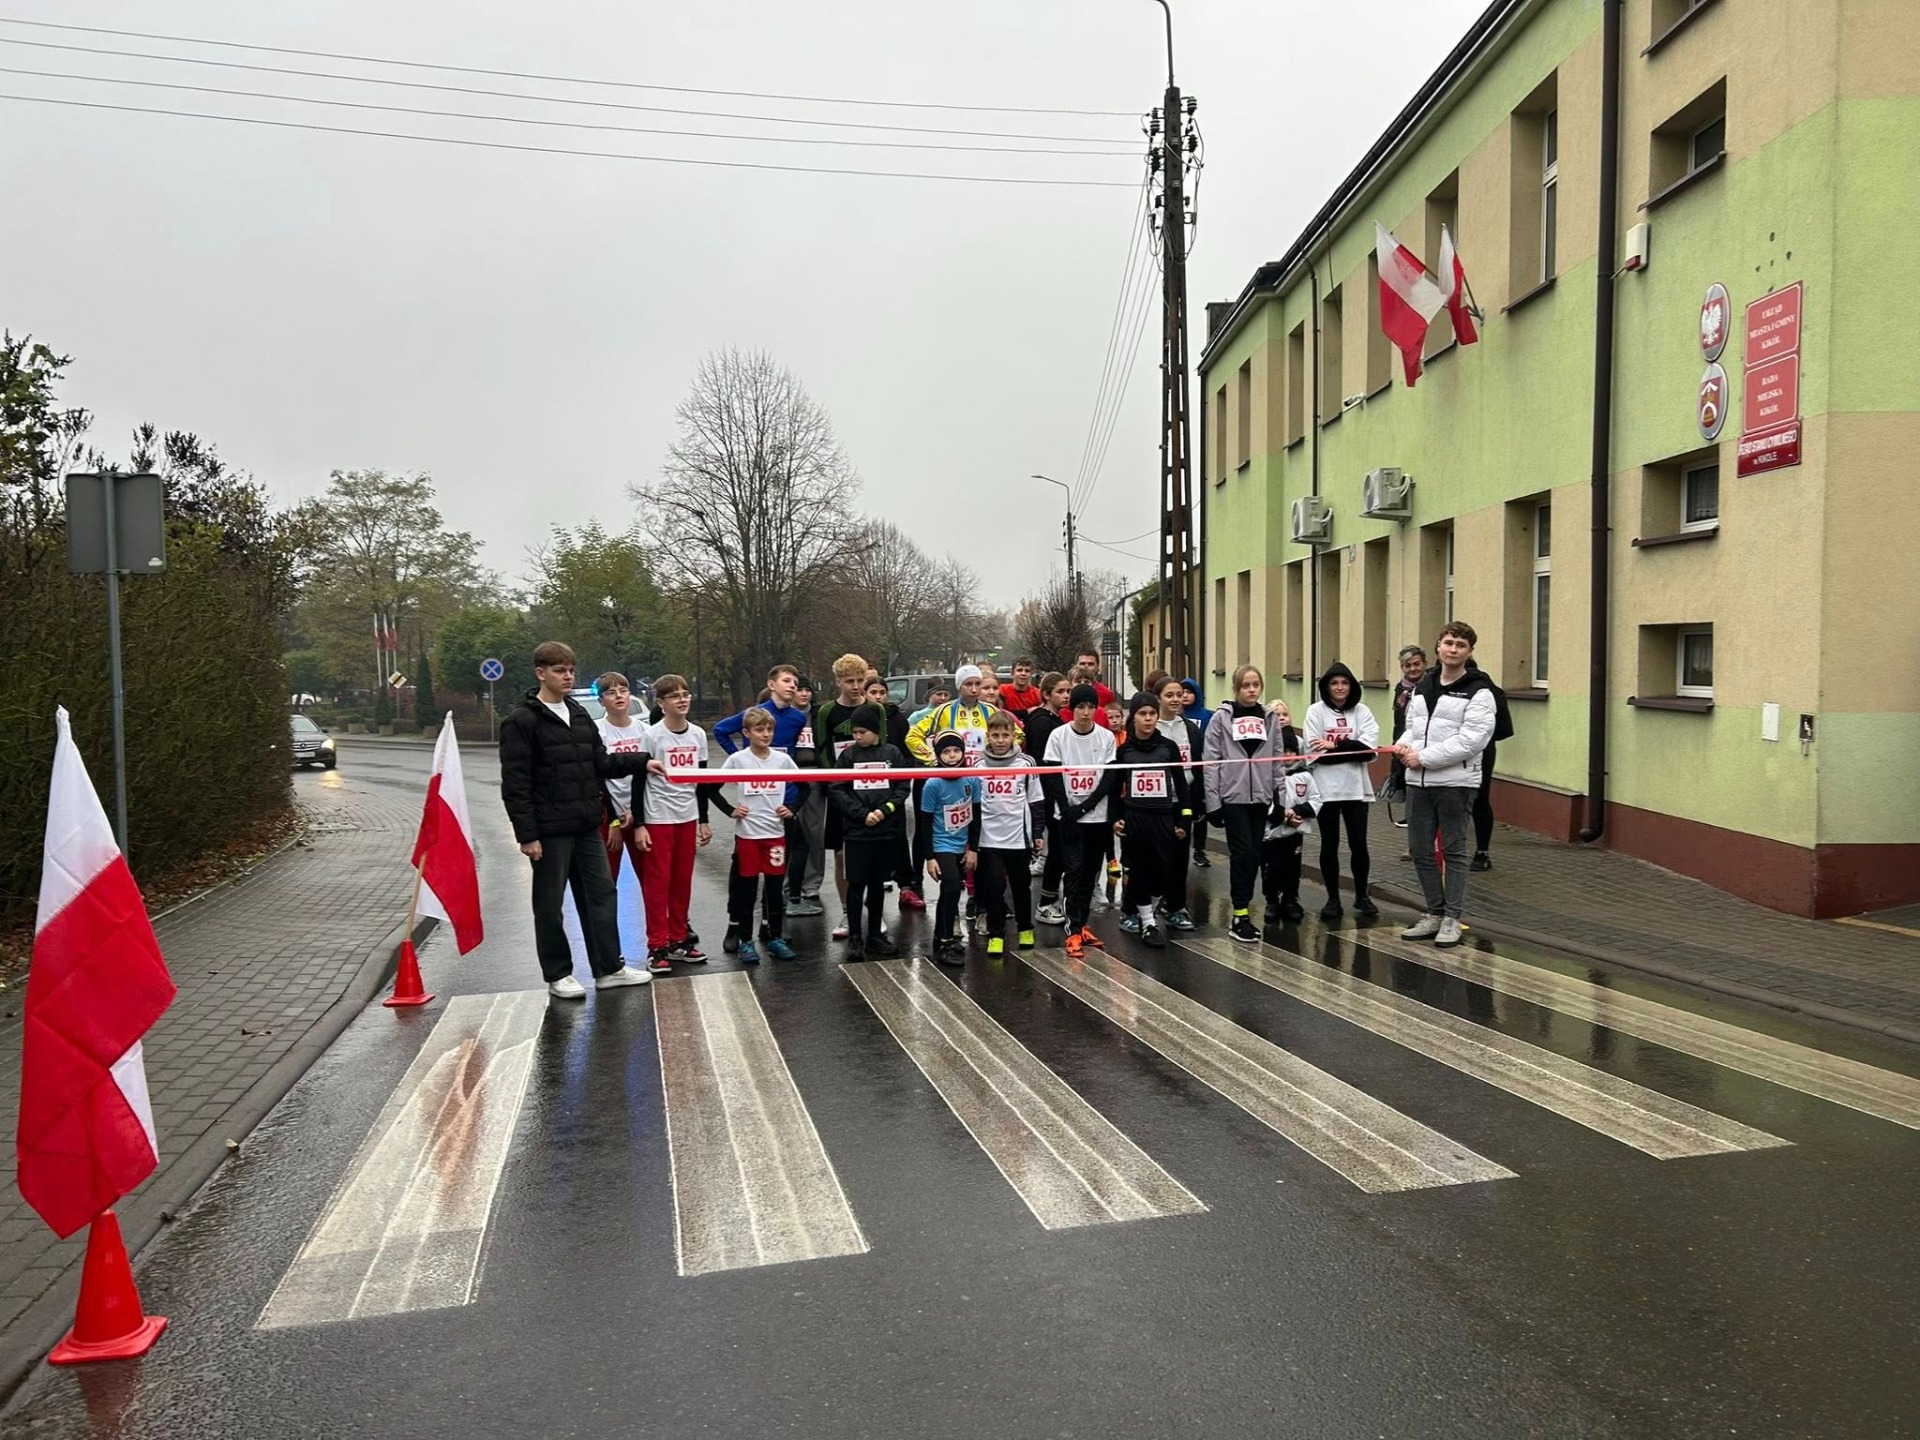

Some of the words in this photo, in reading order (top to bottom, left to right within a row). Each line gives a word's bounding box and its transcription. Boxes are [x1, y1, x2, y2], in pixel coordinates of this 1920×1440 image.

[1238, 723, 1263, 735] 045
[669, 752, 694, 767] 004
[987, 780, 1012, 794] 062
[1071, 777, 1094, 790] 049
[1137, 778, 1161, 792] 051
